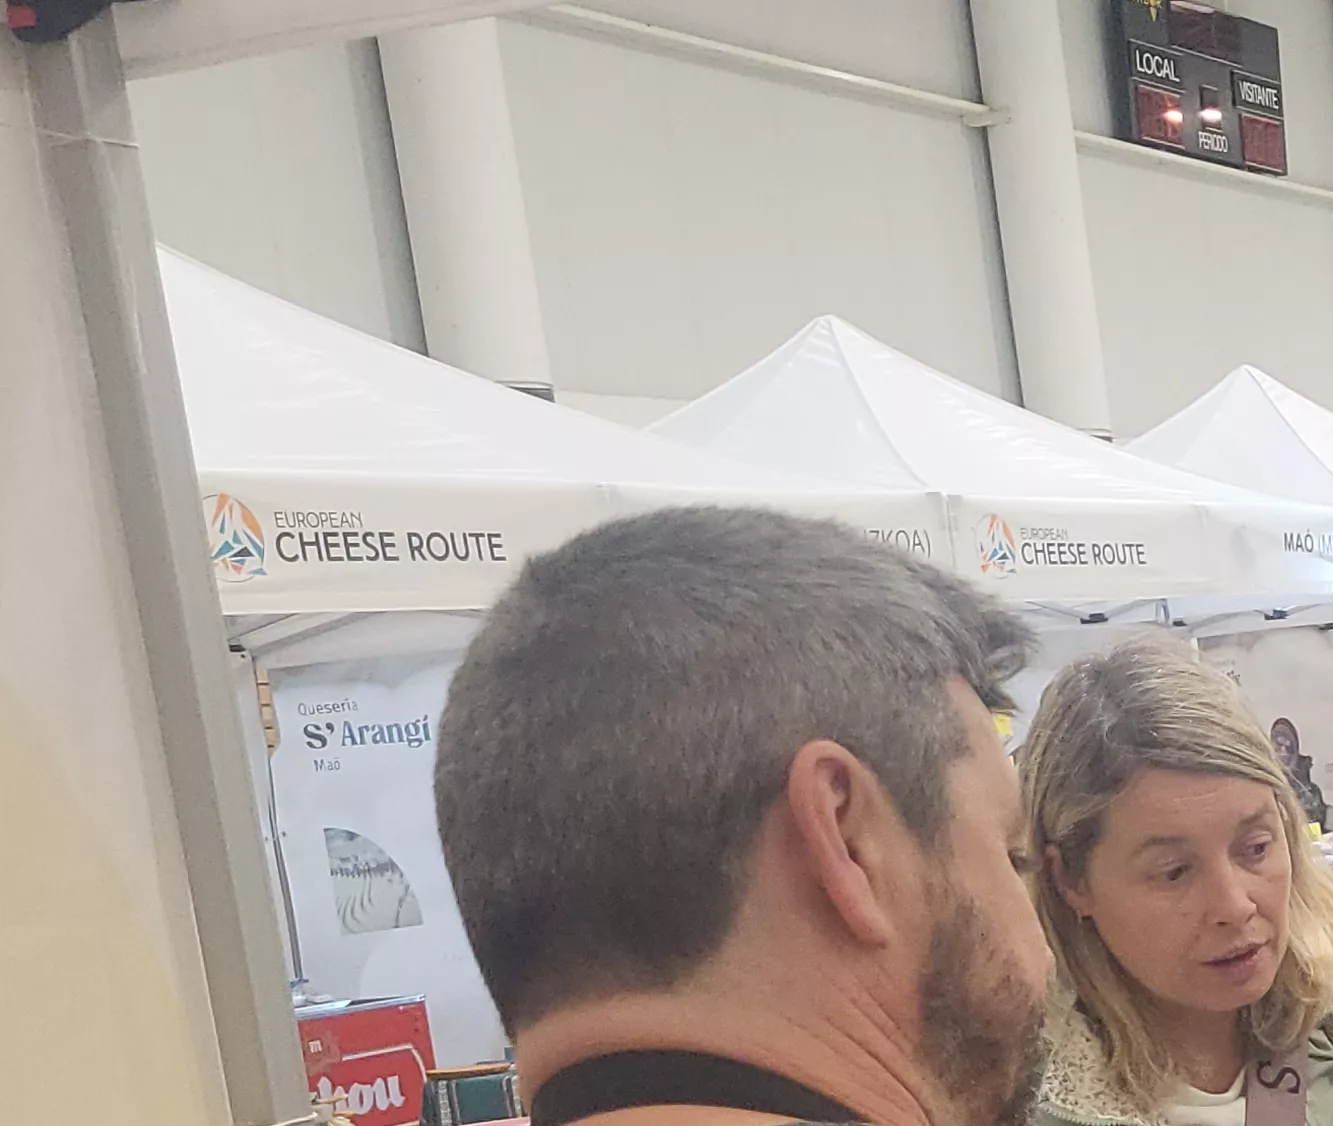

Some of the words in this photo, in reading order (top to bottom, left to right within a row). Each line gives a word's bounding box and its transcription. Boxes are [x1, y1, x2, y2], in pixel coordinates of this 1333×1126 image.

[1136, 49, 1180, 83] LOCAL
[1238, 80, 1279, 110] VISITANTE
[1198, 131, 1228, 153] PERIODO
[273, 510, 363, 529] EUROPEAN
[1020, 527, 1069, 541] EUROPEAN
[1284, 528, 1314, 553] MAÓ
[275, 530, 400, 563] CHEESE
[406, 531, 507, 562] ROUTE
[1021, 542, 1088, 565] CHEESE
[1093, 543, 1147, 565] ROUTE
[297, 697, 359, 717] Quesería
[316, 1074, 406, 1116] hou
